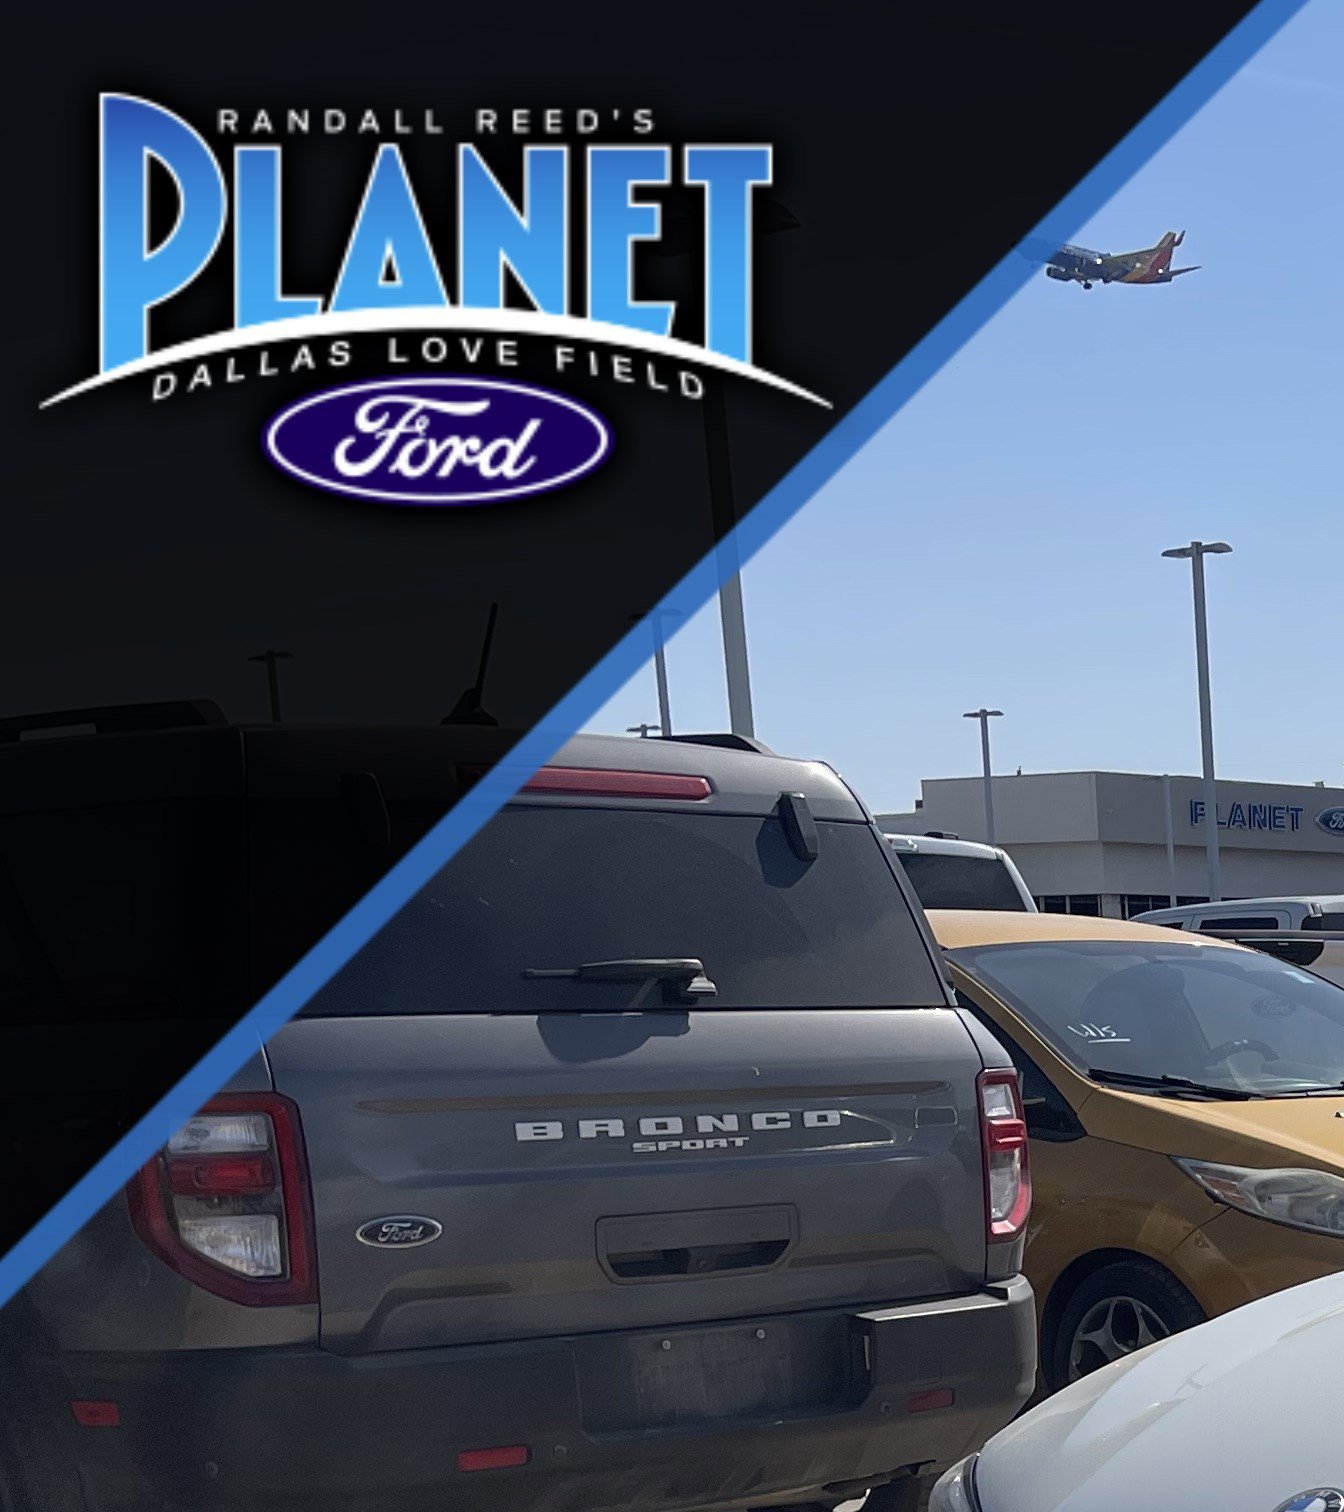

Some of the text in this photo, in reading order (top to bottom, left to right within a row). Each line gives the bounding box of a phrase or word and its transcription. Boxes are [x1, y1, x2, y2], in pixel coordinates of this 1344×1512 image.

[1189, 799, 1304, 832] PLANET
[514, 1109, 842, 1142] BRONCO
[631, 1136, 750, 1153] SPORT
[376, 1222, 426, 1245] Ford
